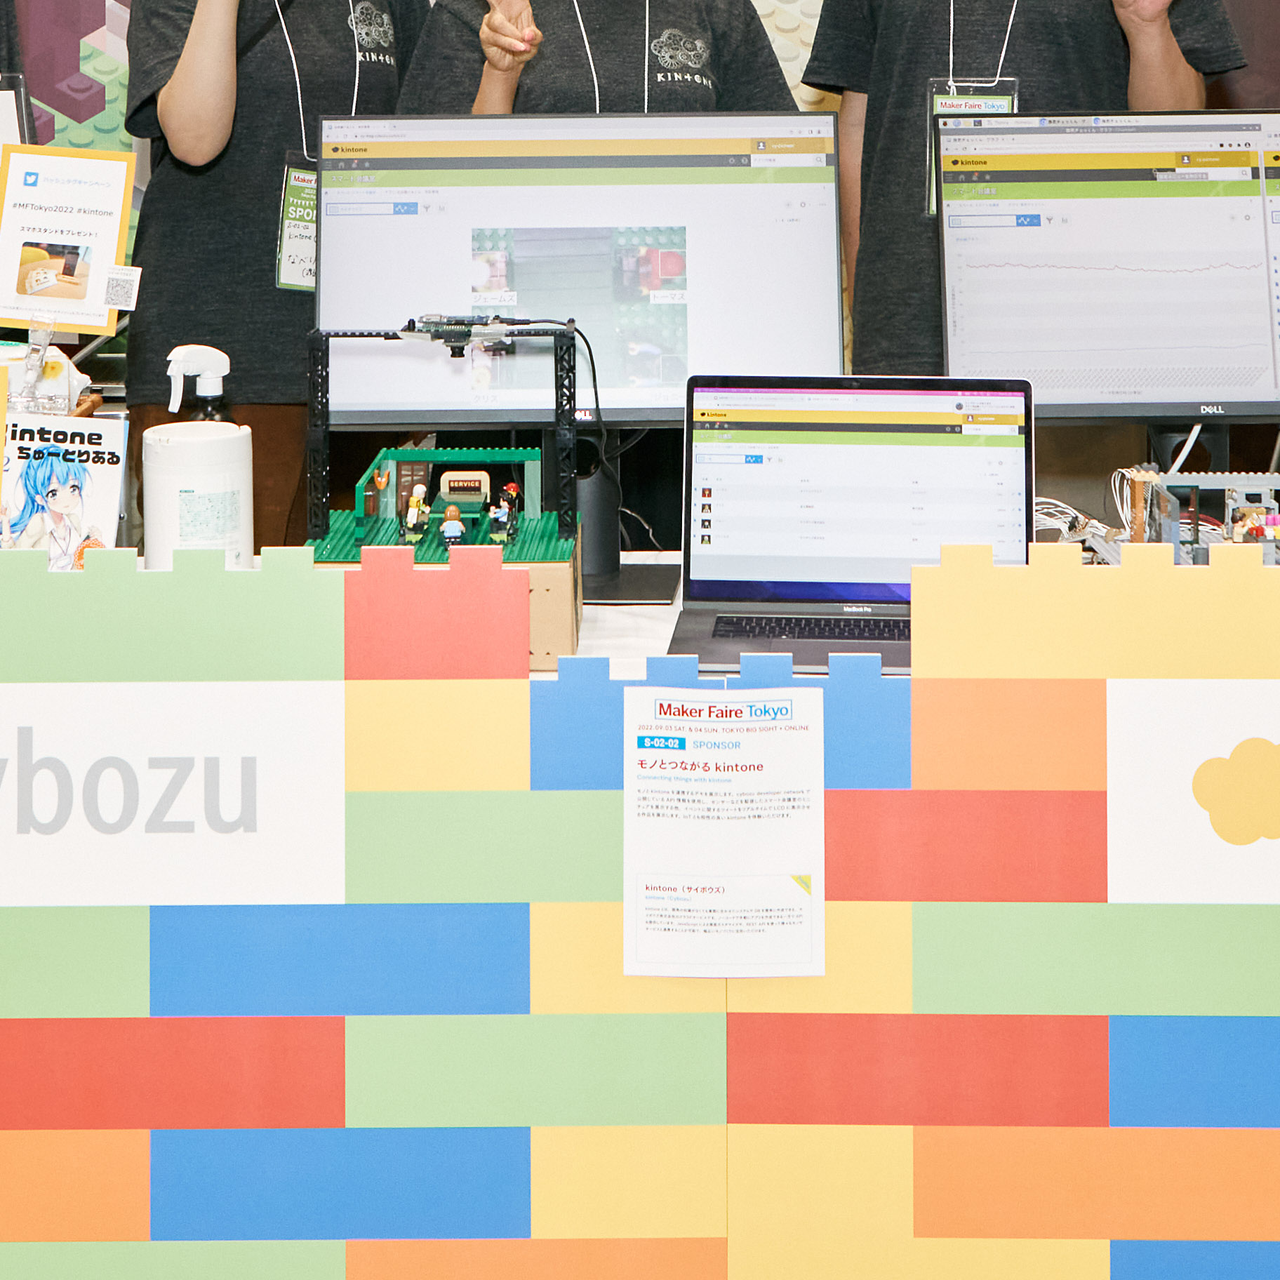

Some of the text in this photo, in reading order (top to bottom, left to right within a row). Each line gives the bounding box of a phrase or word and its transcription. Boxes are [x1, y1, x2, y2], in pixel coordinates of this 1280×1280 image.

[940, 101, 1006, 111] Maker Faire Tokyo
[12, 202, 114, 217] #MFTokyo2022 #kintone
[1200, 405, 1225, 414] DELL
[4, 423, 103, 446] intone
[17, 445, 121, 465] ちゅーとりある
[658, 703, 789, 721] Maker Faire Tokyo
[644, 738, 741, 750] S-02-02 SPONSOR
[637, 759, 764, 772] モノとつながる kintone
[637, 774, 672, 782] Connecting
